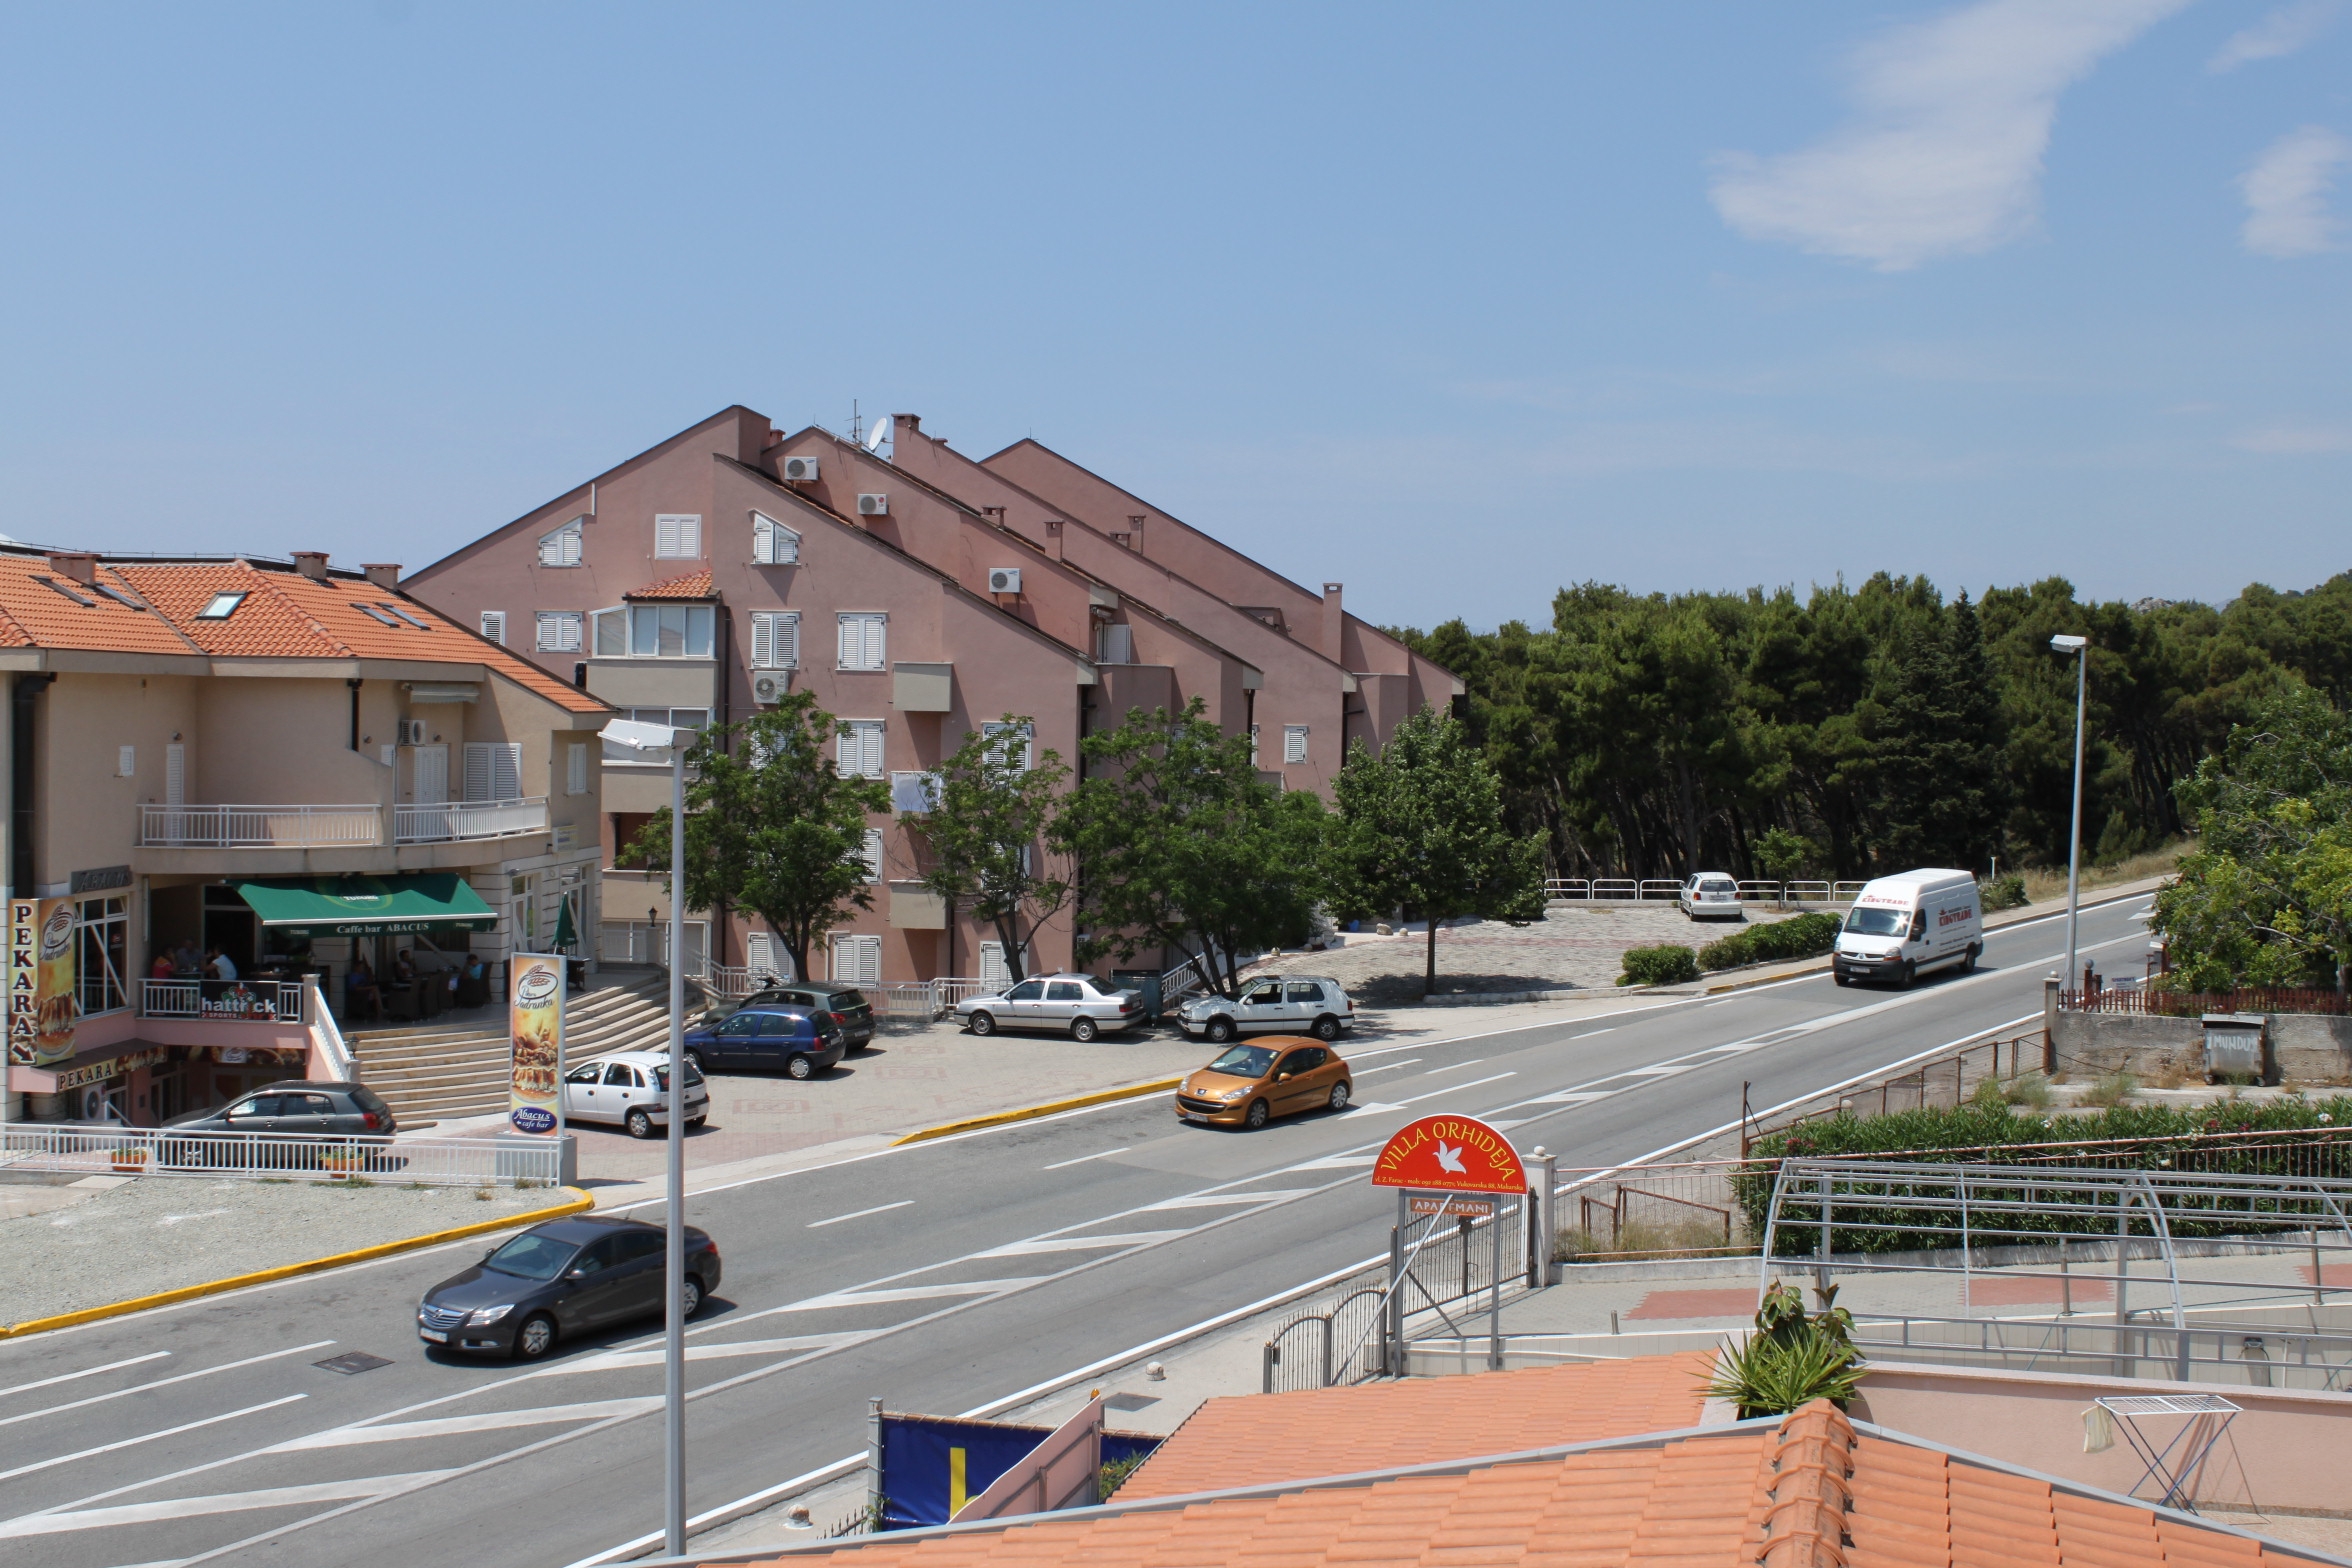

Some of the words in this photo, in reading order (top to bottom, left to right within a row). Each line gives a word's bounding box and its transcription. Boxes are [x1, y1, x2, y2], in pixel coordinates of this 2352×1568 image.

[336, 925, 363, 934] Caffe
[365, 924, 381, 933] bar
[387, 922, 430, 932] ABACUS
[12, 905, 34, 1035] PEKARA
[59, 1062, 113, 1090] PEKARA
[513, 1108, 551, 1121] Abacus
[522, 1120, 536, 1129] cafe
[536, 1121, 549, 1129] bar
[1381, 1127, 1430, 1171] VILLA
[1432, 1121, 1517, 1181] ORHIDEJA
[1414, 1200, 1489, 1213] APATMANI
